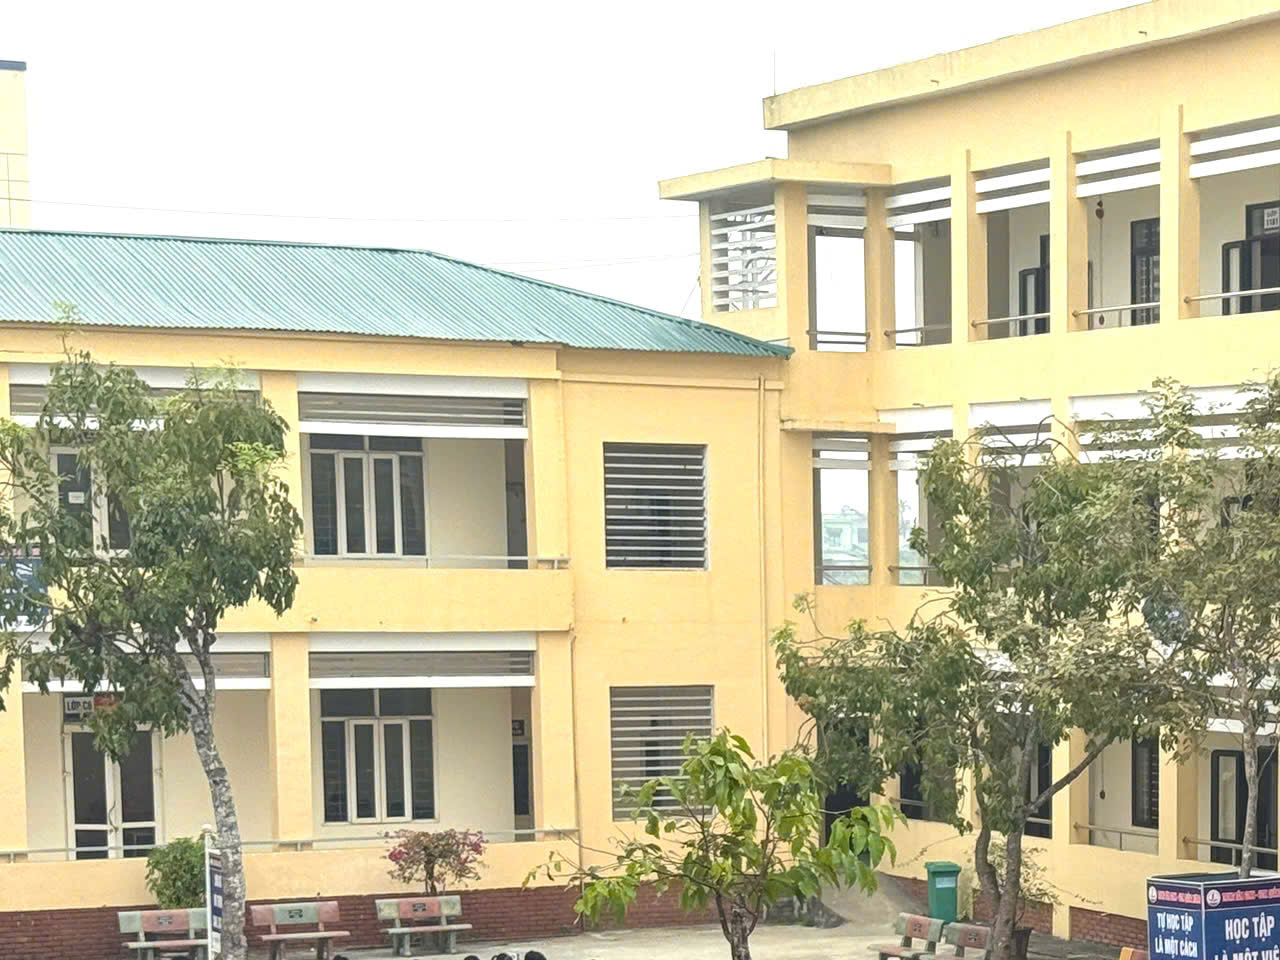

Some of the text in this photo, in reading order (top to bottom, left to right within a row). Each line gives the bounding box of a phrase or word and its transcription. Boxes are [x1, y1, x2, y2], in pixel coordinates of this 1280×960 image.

[1225, 912, 1275, 944] HỌC TẬP
[1155, 934, 1164, 954] LÀ
